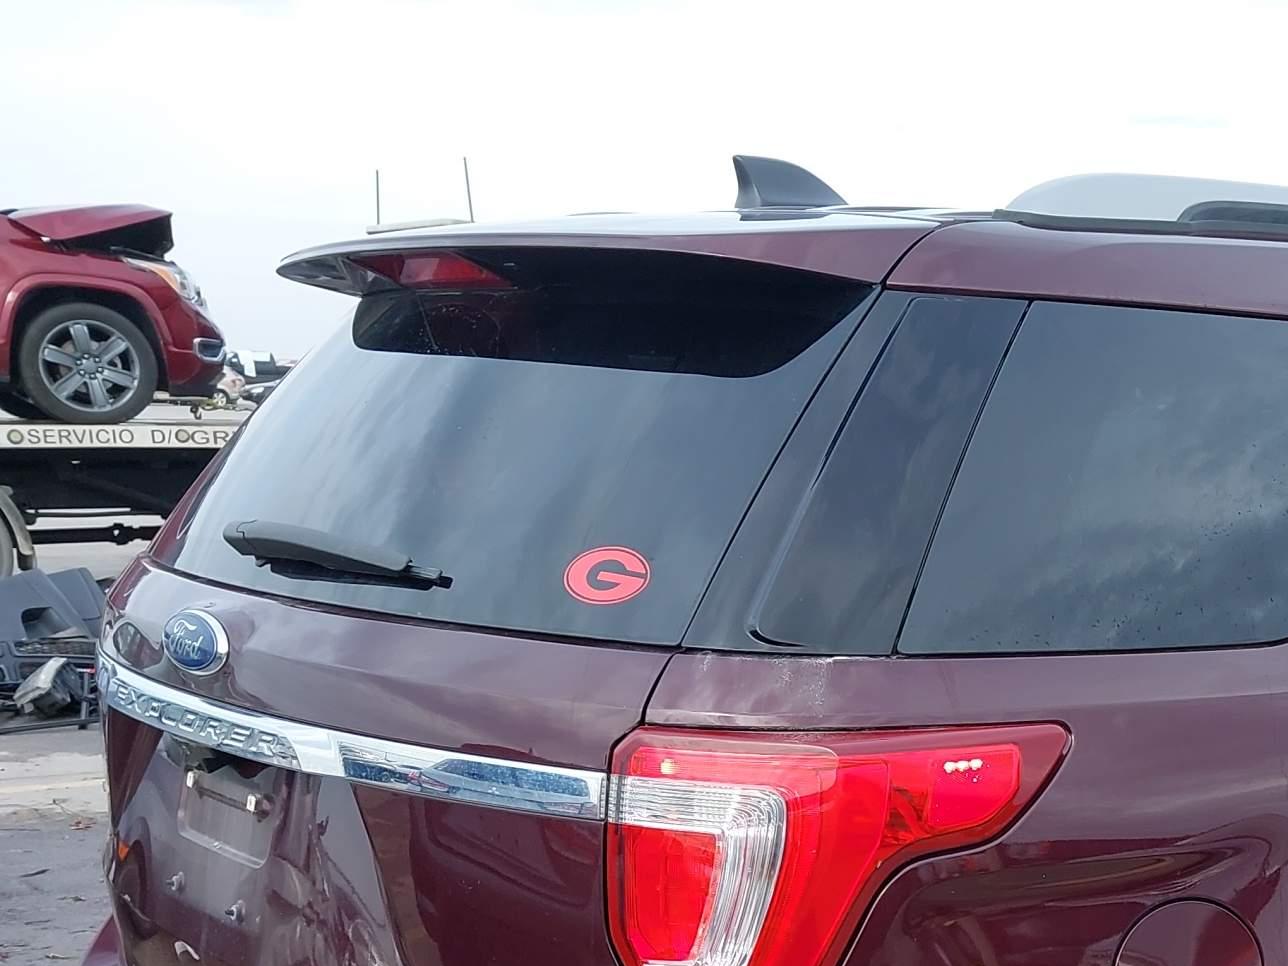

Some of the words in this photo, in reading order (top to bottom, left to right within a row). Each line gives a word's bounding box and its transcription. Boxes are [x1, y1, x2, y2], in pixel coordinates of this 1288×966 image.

[27, 428, 135, 445] SERVICIO
[563, 545, 651, 605] G
[168, 619, 204, 660] Ford
[115, 684, 279, 757] EXPLORER
